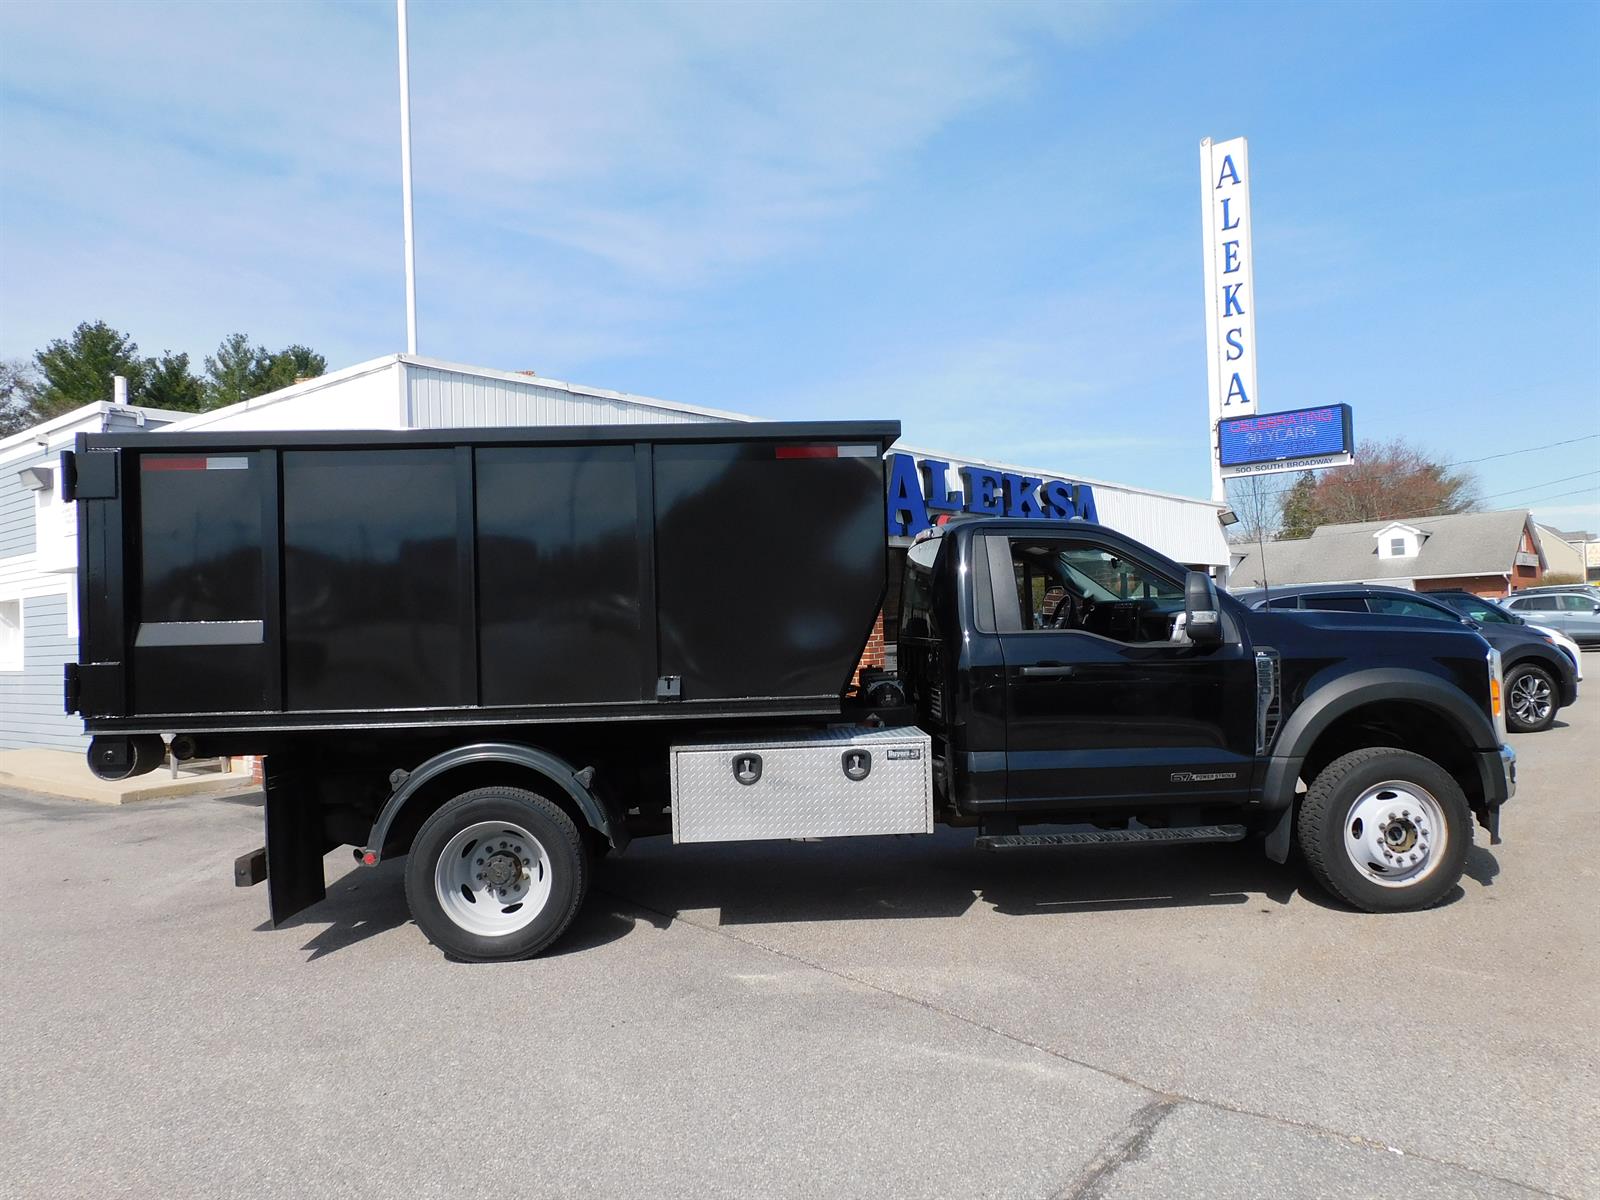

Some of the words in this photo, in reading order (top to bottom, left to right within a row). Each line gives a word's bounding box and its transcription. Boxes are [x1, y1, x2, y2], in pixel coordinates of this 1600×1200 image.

[1215, 154, 1250, 406] ALEKSA
[1229, 409, 1333, 433] CELEBRATING
[1255, 463, 1284, 472] SOUTH
[1286, 457, 1334, 469] BROADWAY
[886, 453, 1100, 538] ALEKSA
